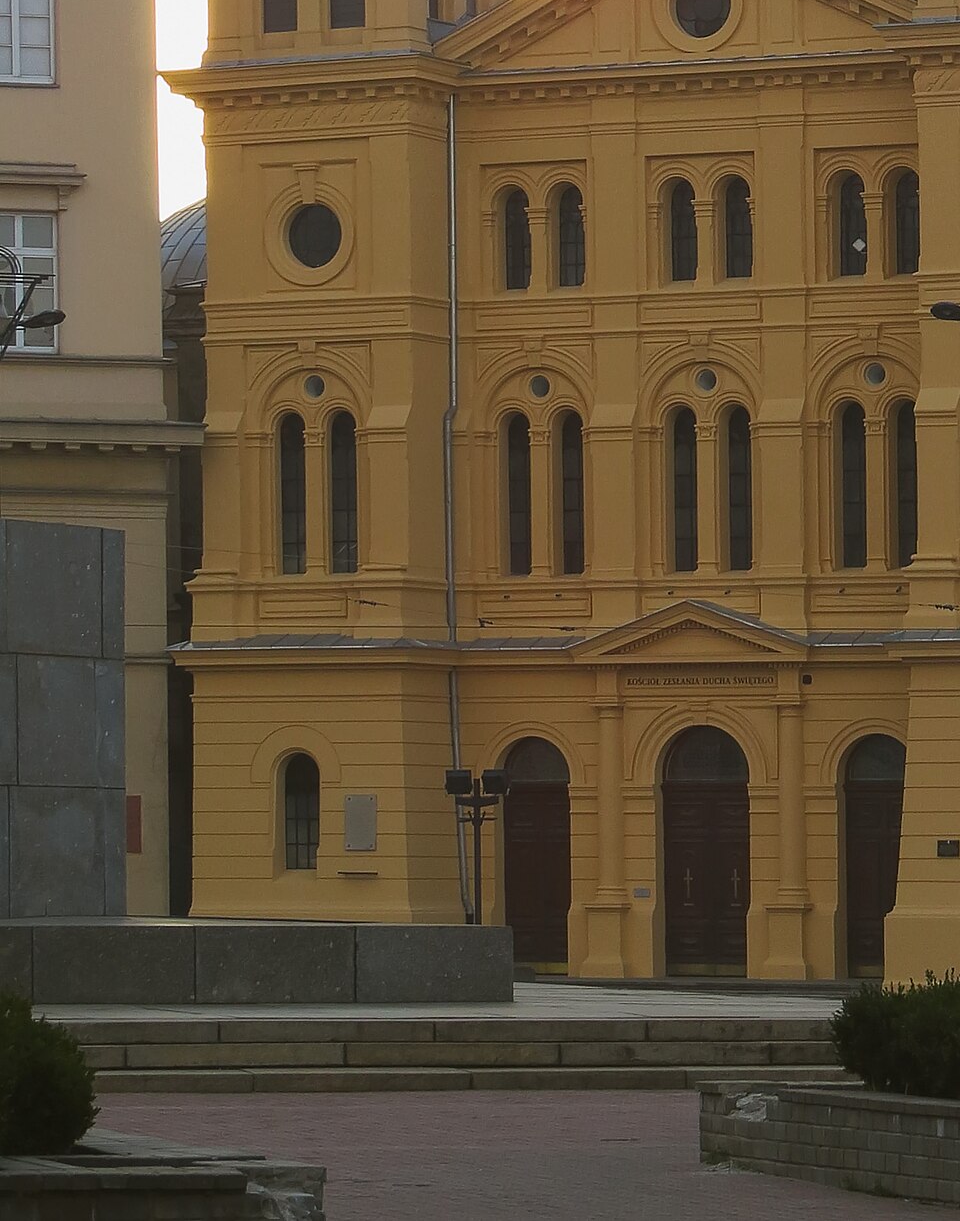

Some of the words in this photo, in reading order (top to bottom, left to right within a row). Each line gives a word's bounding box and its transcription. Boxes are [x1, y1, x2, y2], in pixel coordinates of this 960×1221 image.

[663, 677, 700, 686] ZESŁANIA
[703, 677, 731, 685] DUCHA
[734, 676, 774, 686] ŚWIĘTEGO
